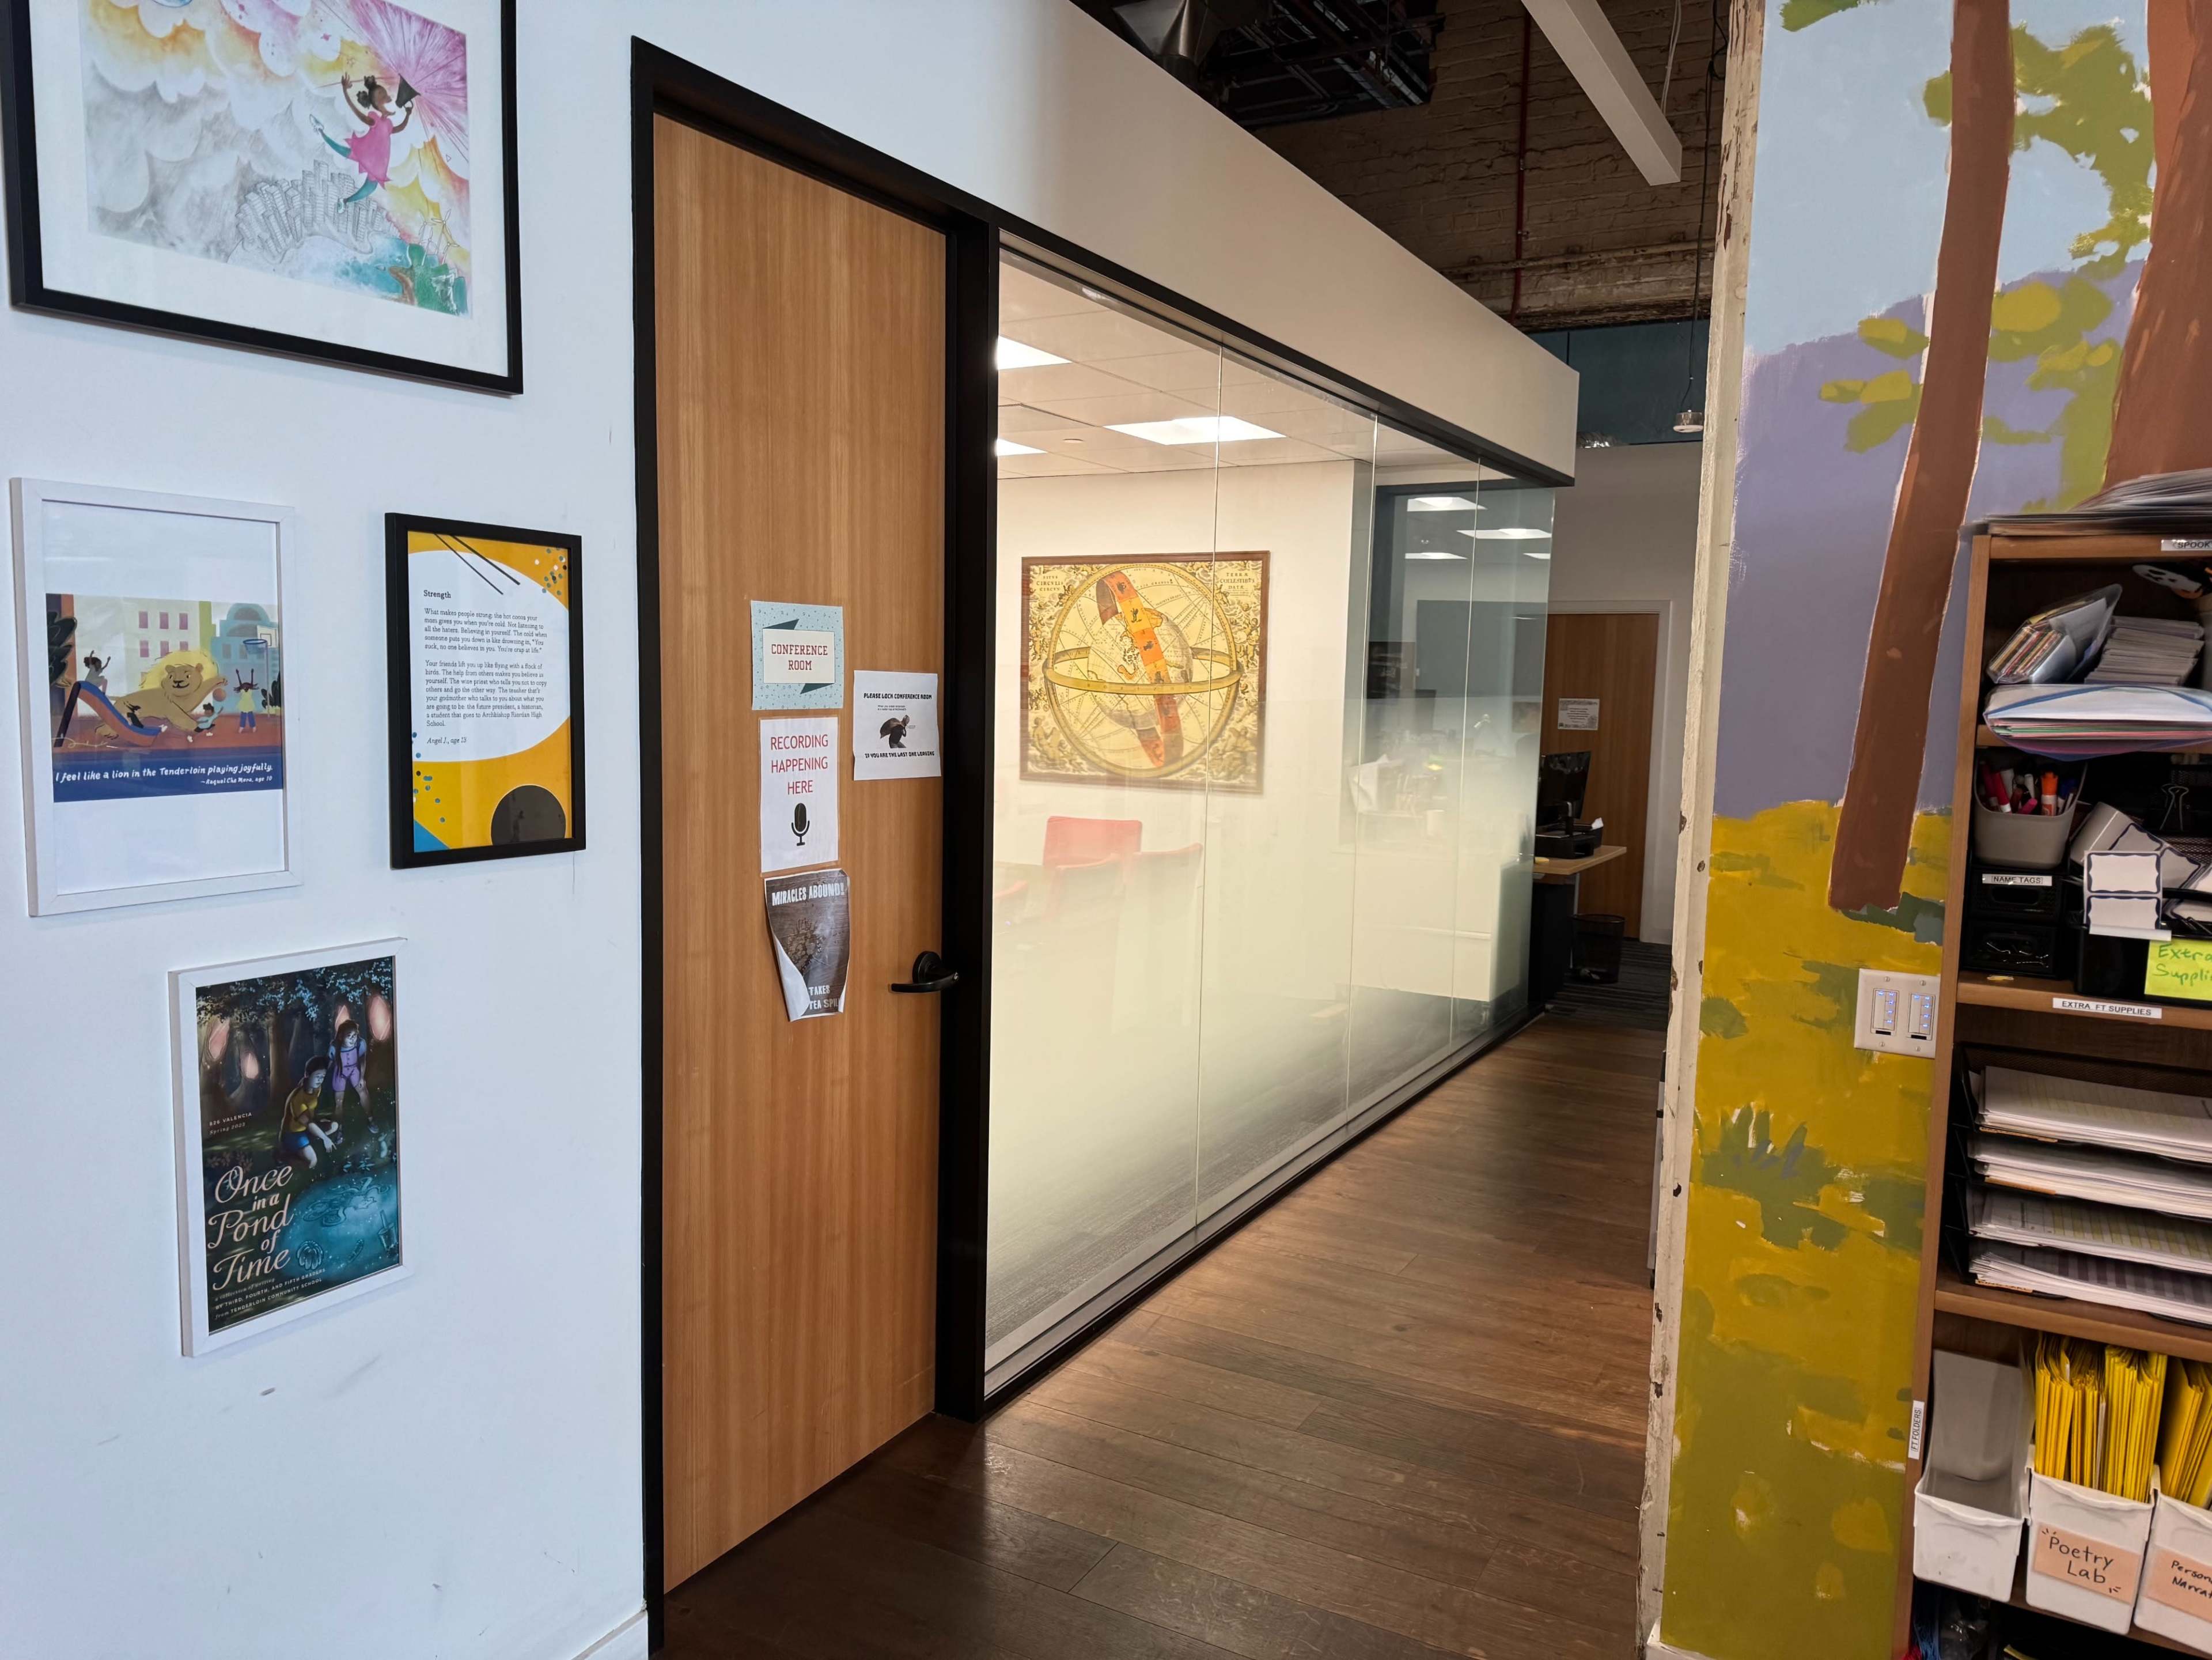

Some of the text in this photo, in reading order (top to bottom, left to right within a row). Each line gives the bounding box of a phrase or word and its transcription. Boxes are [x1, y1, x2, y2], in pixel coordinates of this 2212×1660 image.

[423, 590, 451, 600] Strength
[771, 644, 828, 656] CONFERENCE
[453, 670, 464, 678] help
[788, 660, 812, 671] ROOM
[427, 737, 442, 746] Angel
[771, 734, 828, 750] RECORDING
[771, 756, 828, 773] HAPPENING
[56, 773, 59, 781] I
[60, 772, 81, 784] feel
[83, 770, 101, 780] like
[112, 770, 129, 779] lion
[142, 768, 156, 777] the
[160, 766, 206, 776] Tenderloin
[207, 765, 238, 776] playing
[238, 763, 272, 774] joyfully.
[788, 780, 813, 795] HERE
[772, 883, 846, 906] MIRACLES ABOUND!
[2158, 943, 2212, 961] Extra
[808, 985, 830, 996] TAKES
[809, 1000, 821, 1009] TEA
[2062, 1001, 2090, 1010] EXTRA
[2108, 1005, 2152, 1016] SUPPLIES
[222, 1112, 252, 1123] VALENCIA
[215, 1166, 293, 1204] Once
[252, 1194, 279, 1211] in a
[207, 1193, 294, 1249] Pond
[260, 1229, 279, 1253] of
[213, 1249, 290, 1291] Time
[285, 1277, 300, 1285] FIFTH
[301, 1269, 325, 1279] GRADERS
[230, 1298, 266, 1313] TENDERLOIN
[268, 1287, 299, 1299] COMMUNITY
[301, 1278, 322, 1288] SCHOOL
[1911, 1409, 1921, 1450] FT FOLDERS
[2049, 1536, 2113, 1570] Poetry
[2067, 1562, 2106, 1585] Lab
